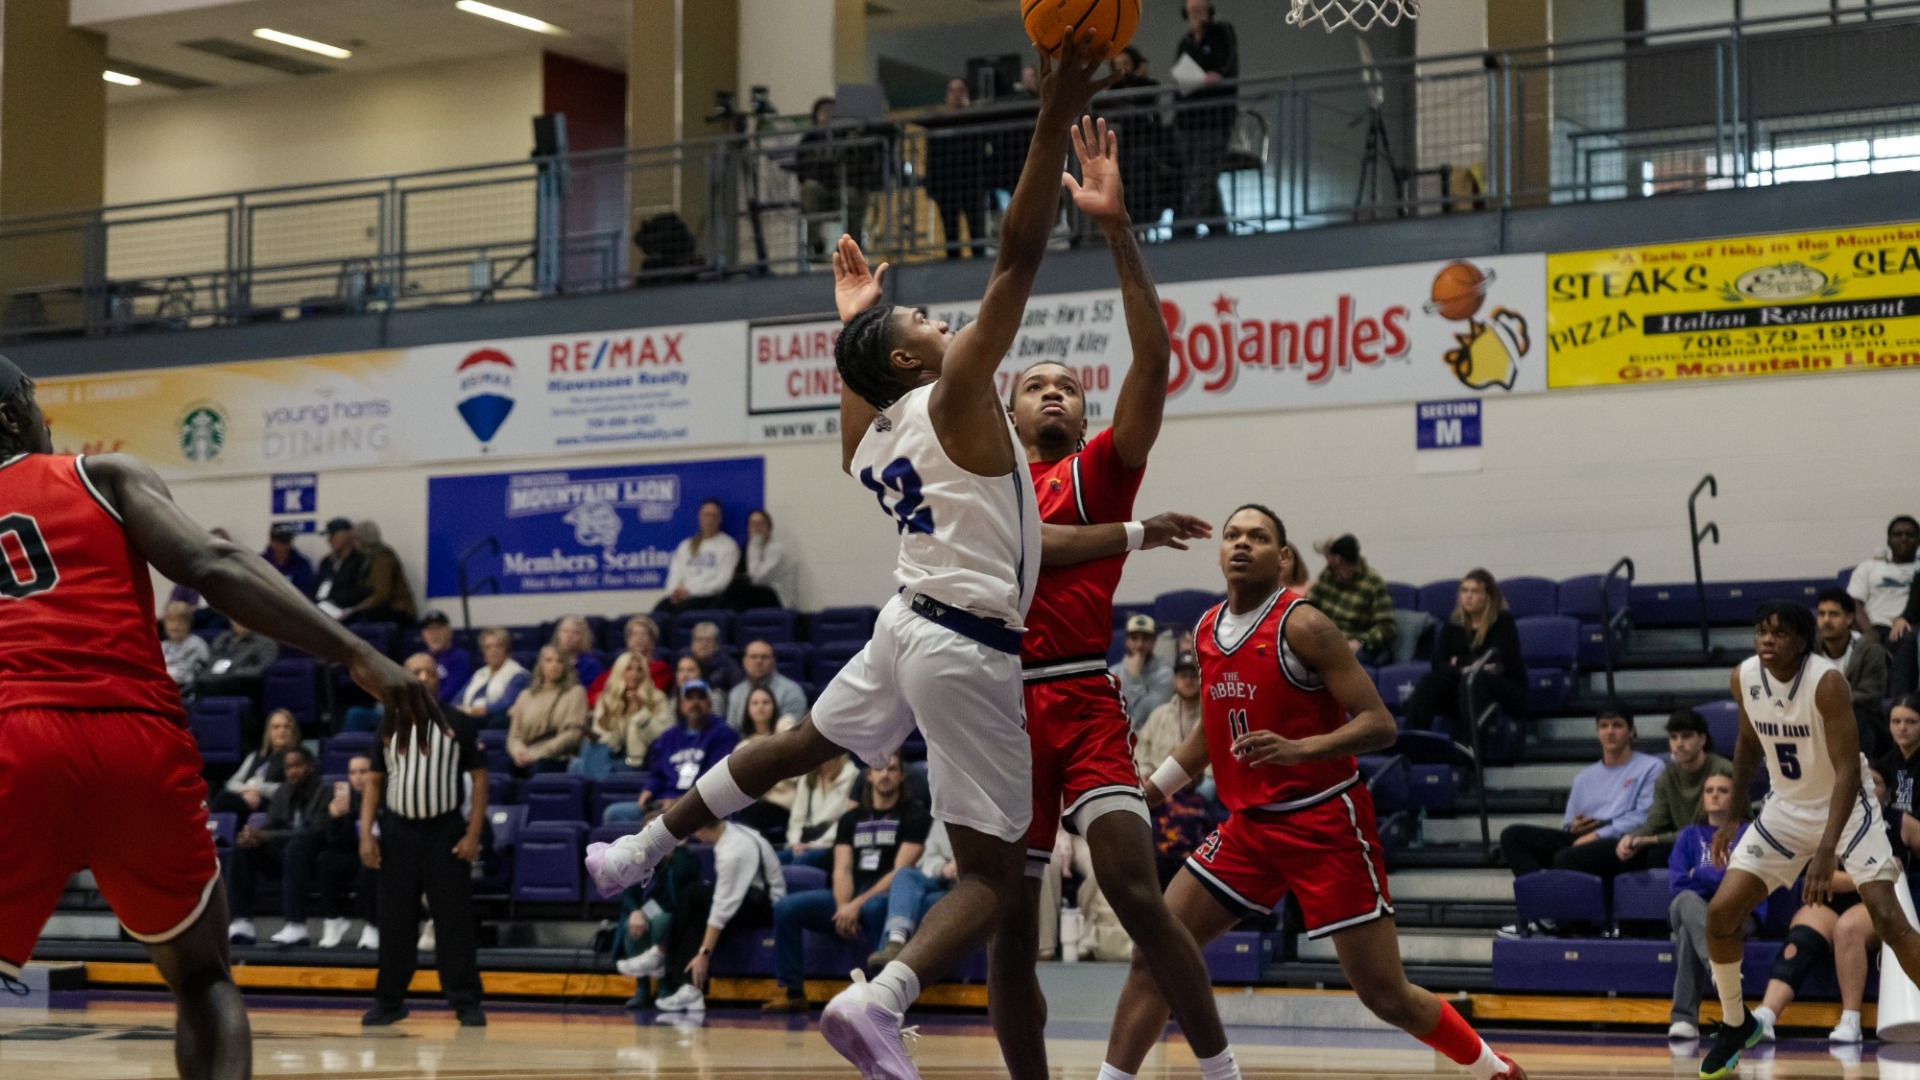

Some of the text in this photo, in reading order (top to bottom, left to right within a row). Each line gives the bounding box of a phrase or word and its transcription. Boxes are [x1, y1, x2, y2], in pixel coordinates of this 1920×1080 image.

[1694, 246, 1715, 259] of
[1722, 244, 1764, 257] Italy
[1770, 243, 1790, 253] in
[1797, 237, 1829, 250] the
[1852, 246, 1920, 278] SEA
[1552, 265, 1709, 303] STEAKS
[1091, 297, 1117, 322] 515
[1660, 298, 1906, 333] Italian Restaurant
[1018, 335, 1072, 358] Bowling
[1075, 330, 1109, 353] Alley
[1549, 310, 1637, 353] PIZZA
[1680, 322, 1884, 350] 706-379-1950
[549, 333, 685, 373] RE/MAX
[1618, 365, 1665, 382] Go
[1676, 353, 1832, 377] Mountain
[637, 370, 688, 386] Realty
[262, 399, 391, 428] young harris
[1420, 402, 1479, 420] SECTION
[261, 424, 391, 459] DINING
[1436, 418, 1462, 446] M
[284, 489, 303, 511] K
[511, 481, 618, 511] MOUNTAIN
[622, 478, 675, 502] LION
[502, 548, 598, 576] Members
[602, 544, 675, 573] Seatin
[1209, 682, 1258, 701] ABBEY
[1222, 672, 1240, 682] THE
[1228, 708, 1254, 758] 11
[1773, 742, 1803, 782] 5
